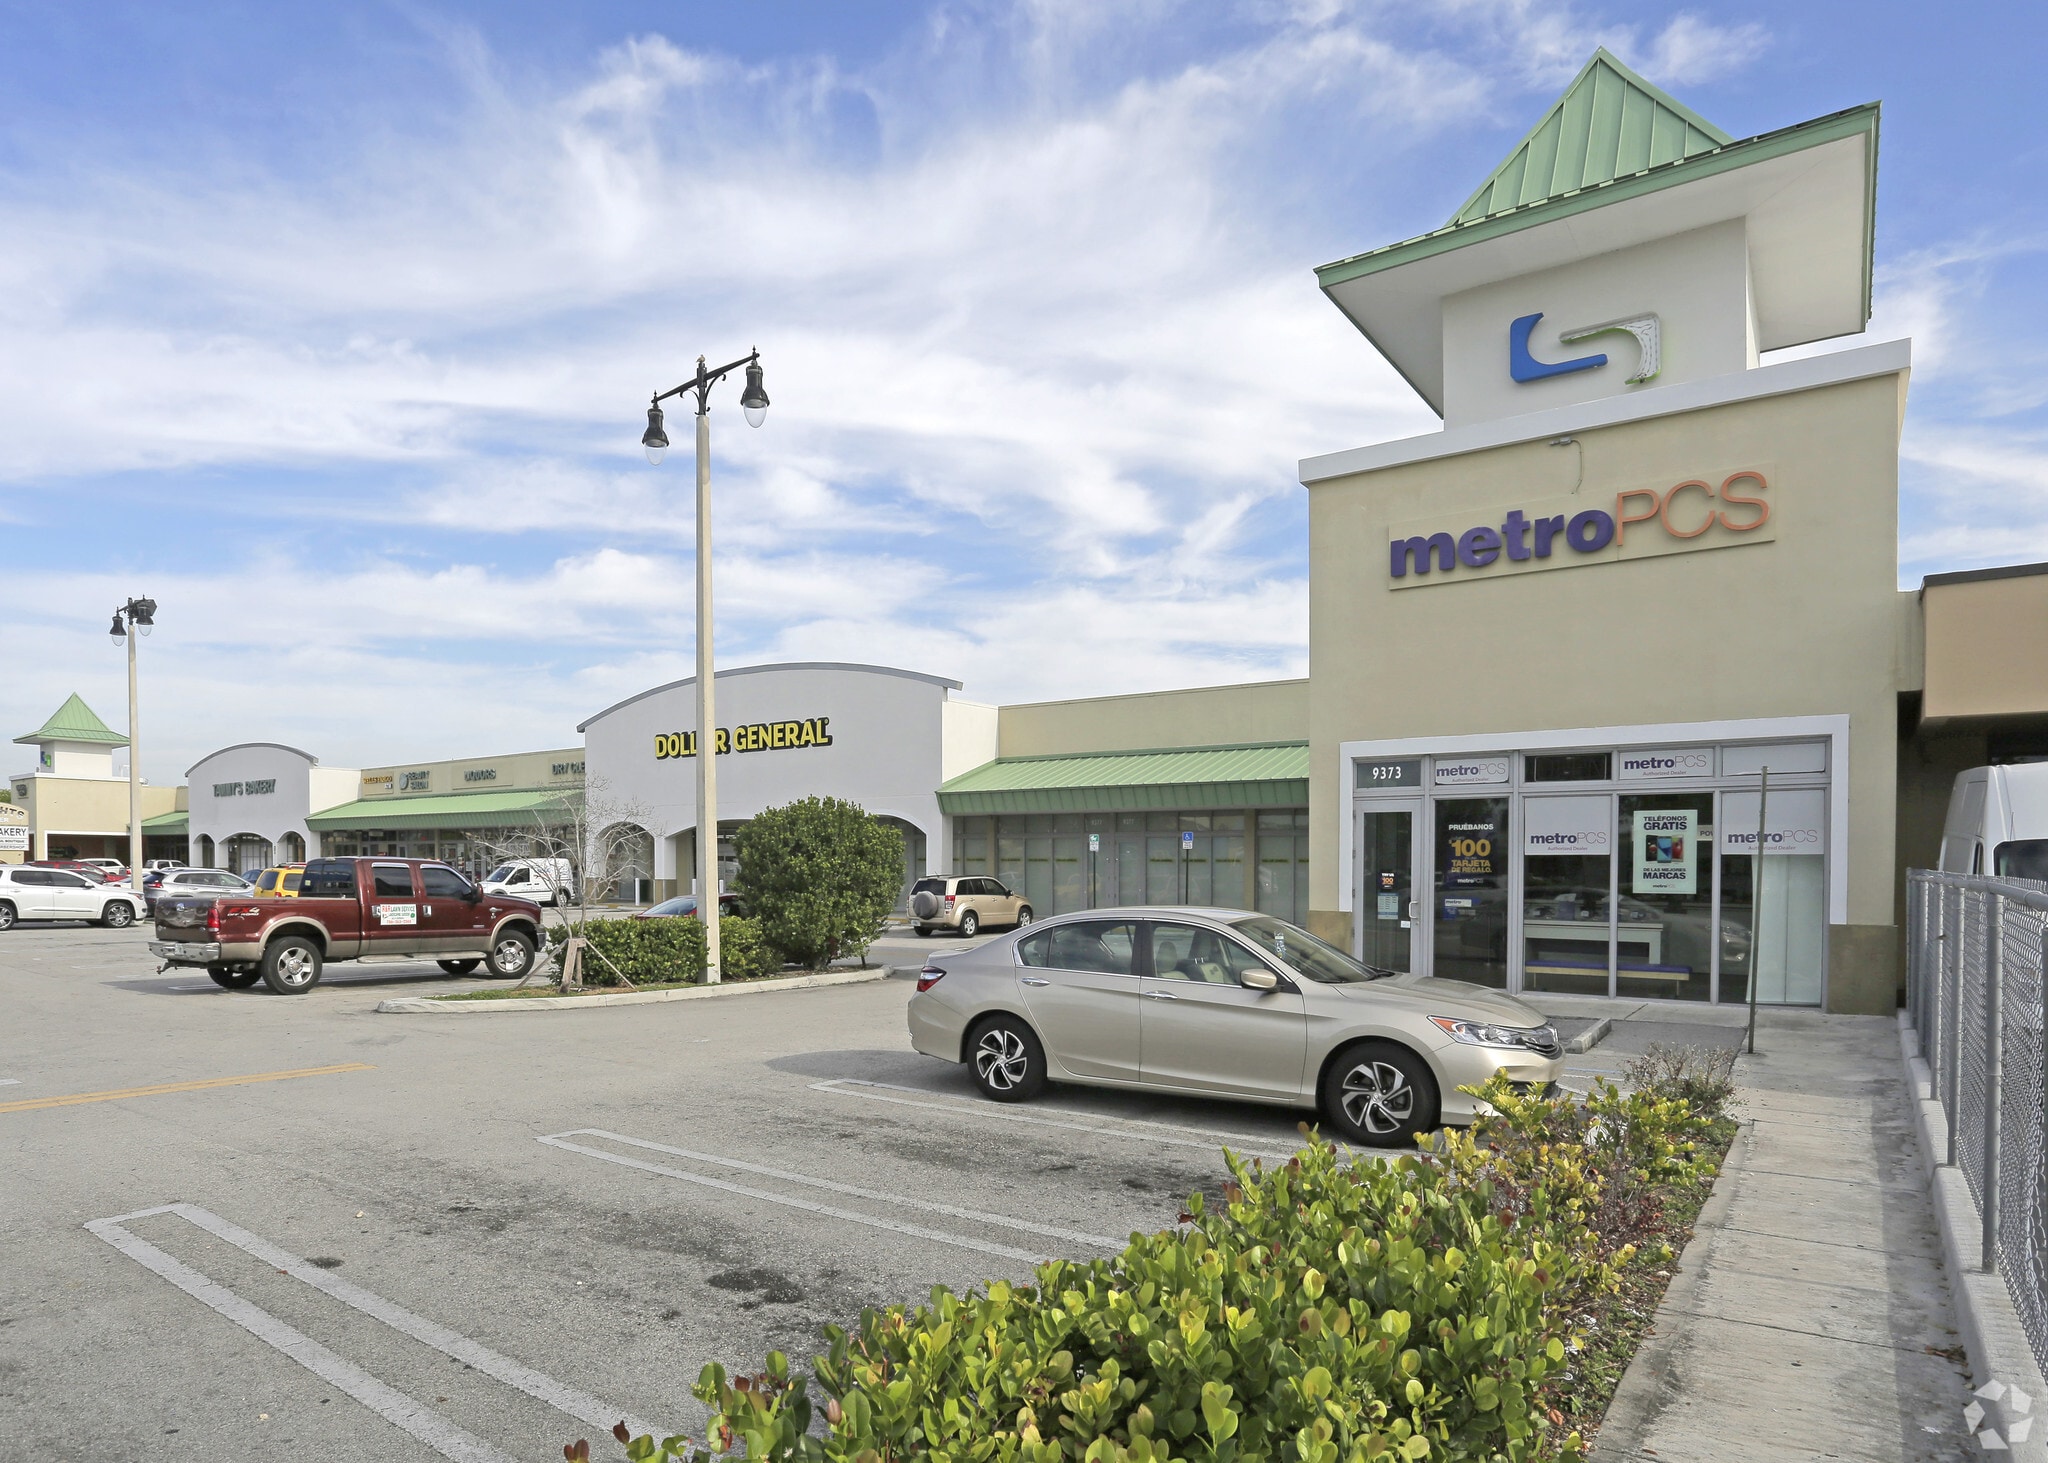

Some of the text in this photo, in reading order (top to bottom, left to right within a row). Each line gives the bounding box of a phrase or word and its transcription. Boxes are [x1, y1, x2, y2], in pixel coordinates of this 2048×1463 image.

[1390, 471, 1770, 577] metroPCS
[655, 717, 833, 759] DOLLR GENERAL
[1624, 755, 1707, 770] metroPCS
[464, 768, 496, 781] LIQUORS
[1372, 766, 1402, 779] 9373
[1436, 763, 1506, 776] metroPCS
[1643, 822, 1687, 830] GRATIS
[1530, 832, 1607, 844] metroPCS
